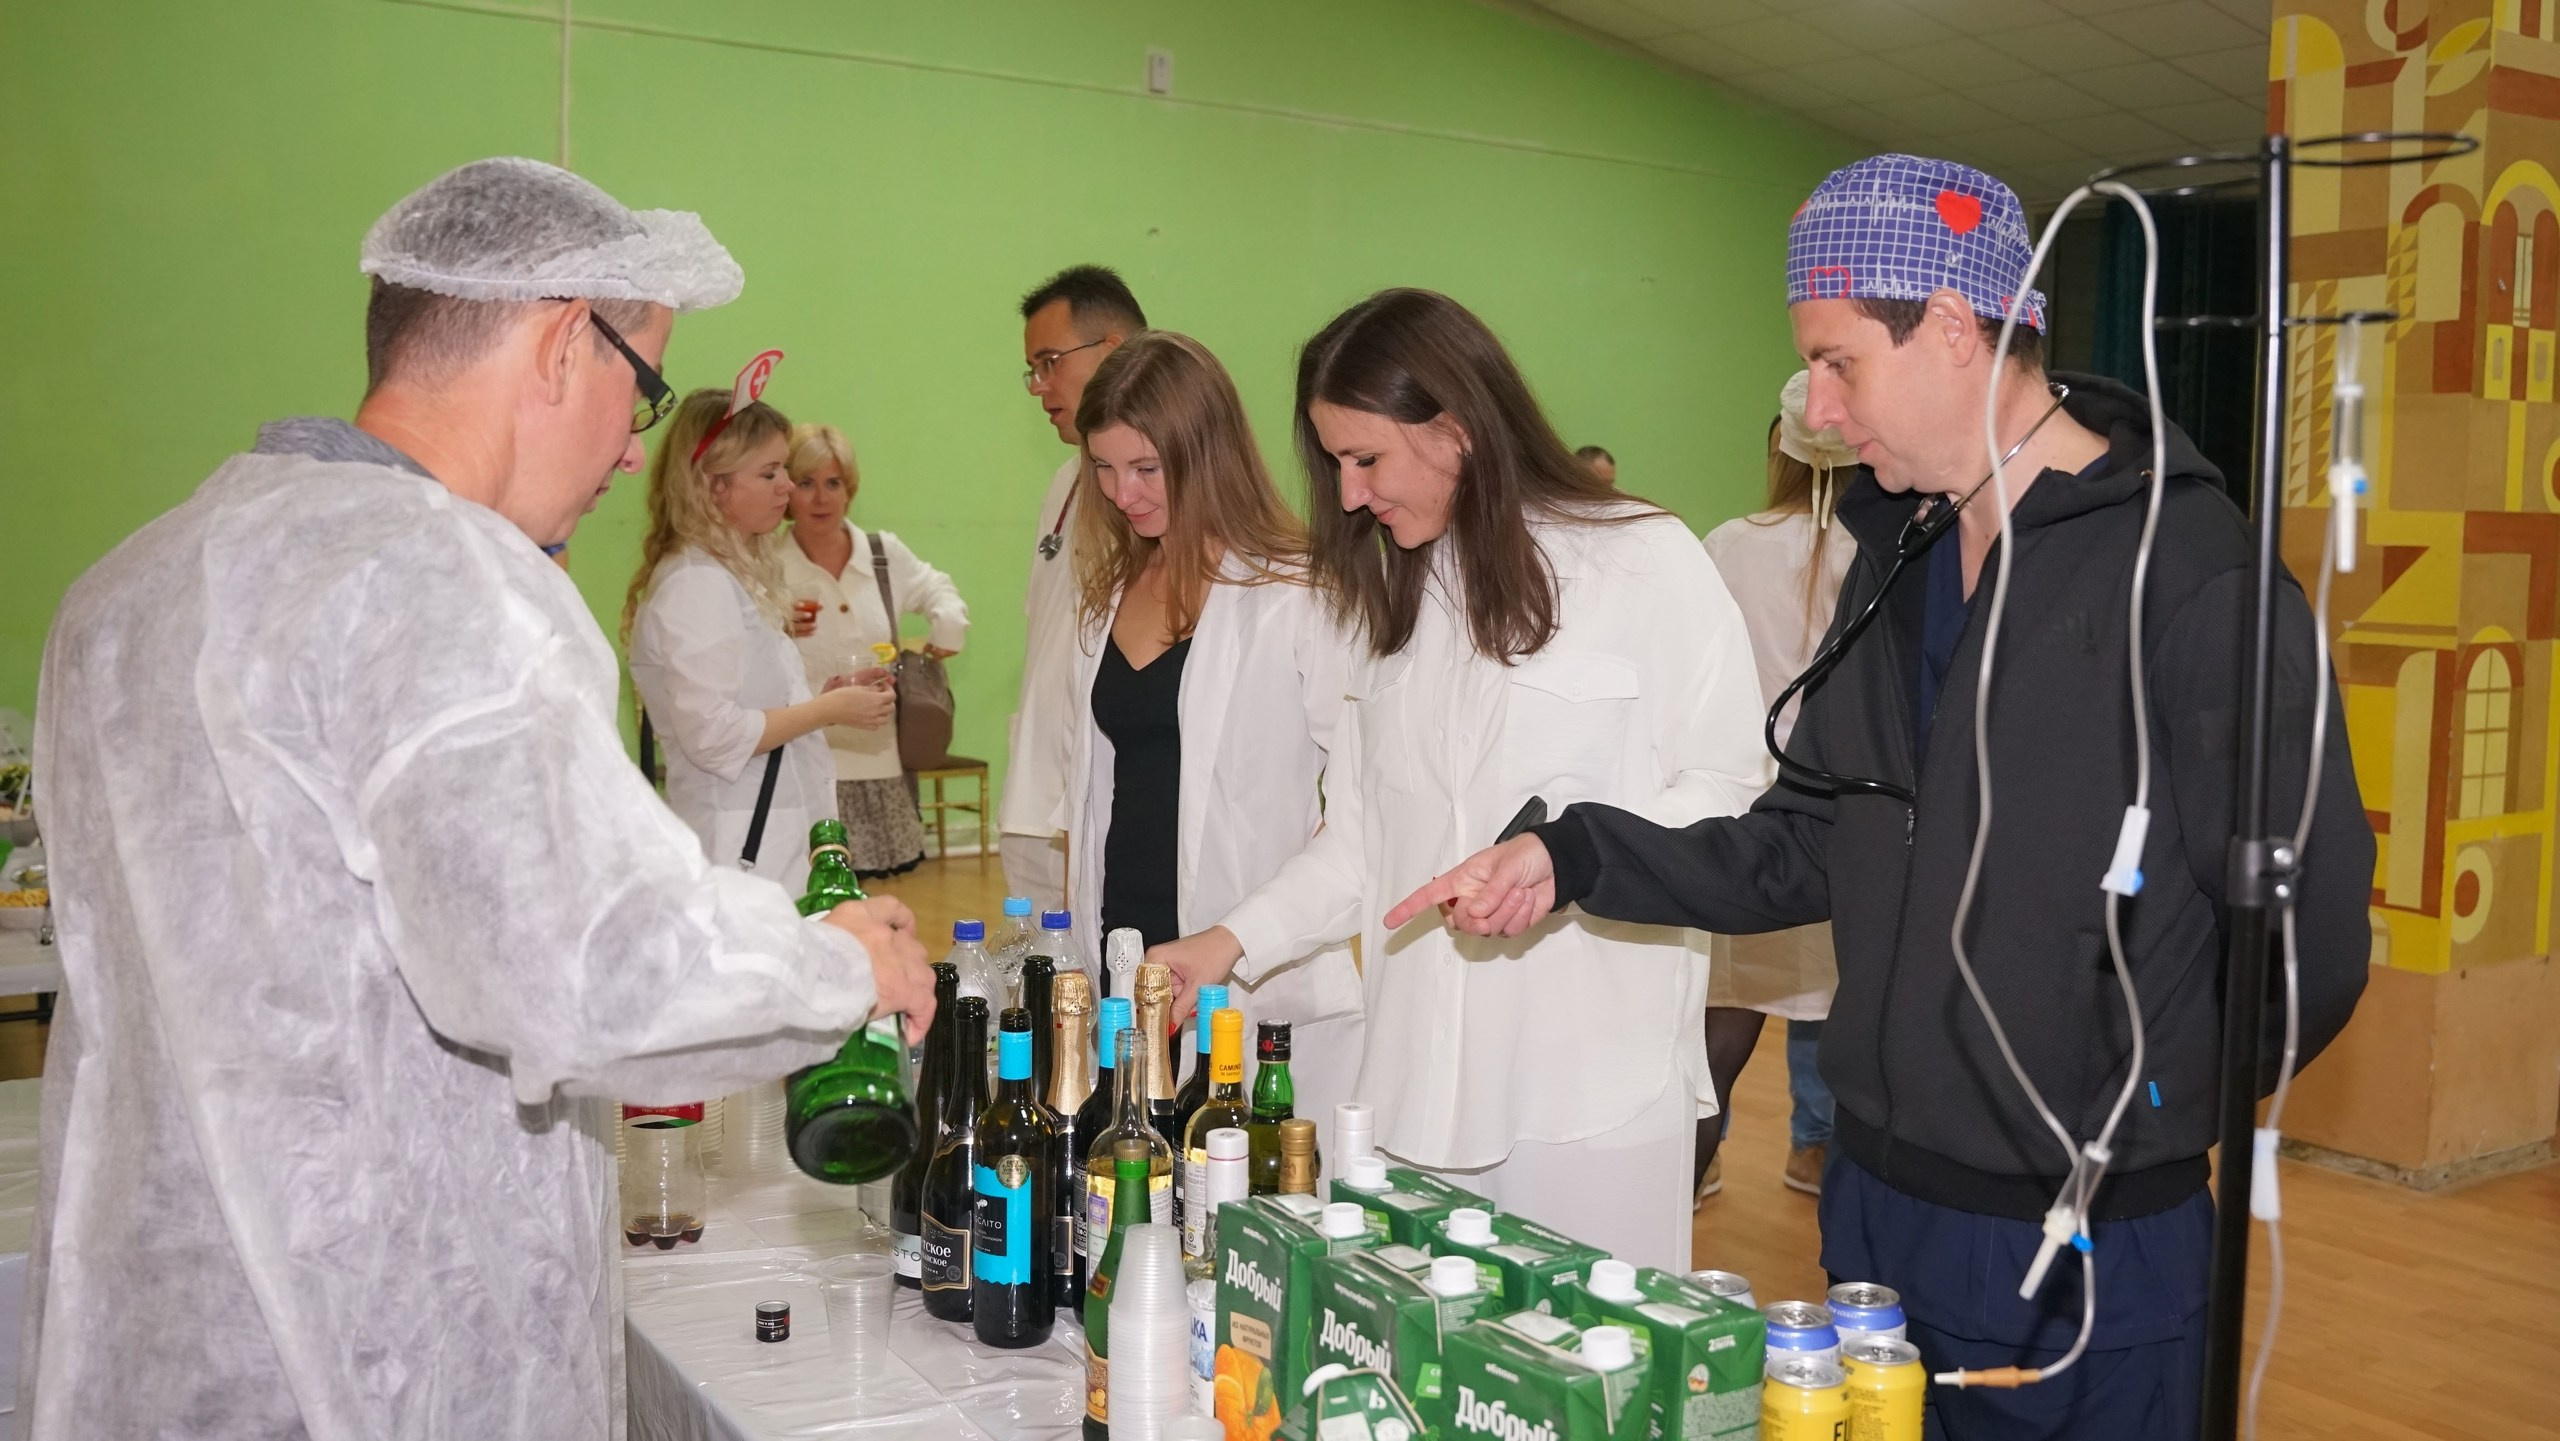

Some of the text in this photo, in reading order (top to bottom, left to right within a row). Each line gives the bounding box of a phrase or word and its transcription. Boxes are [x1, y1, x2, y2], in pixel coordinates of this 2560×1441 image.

[974, 1216, 1002, 1230] SCAITO
[922, 1239, 952, 1258] тское
[1225, 1248, 1284, 1313] Добрый
[1190, 1315, 1208, 1342] КА
[1319, 1307, 1392, 1377] Добрый
[1454, 1384, 1562, 1441] Добрый
